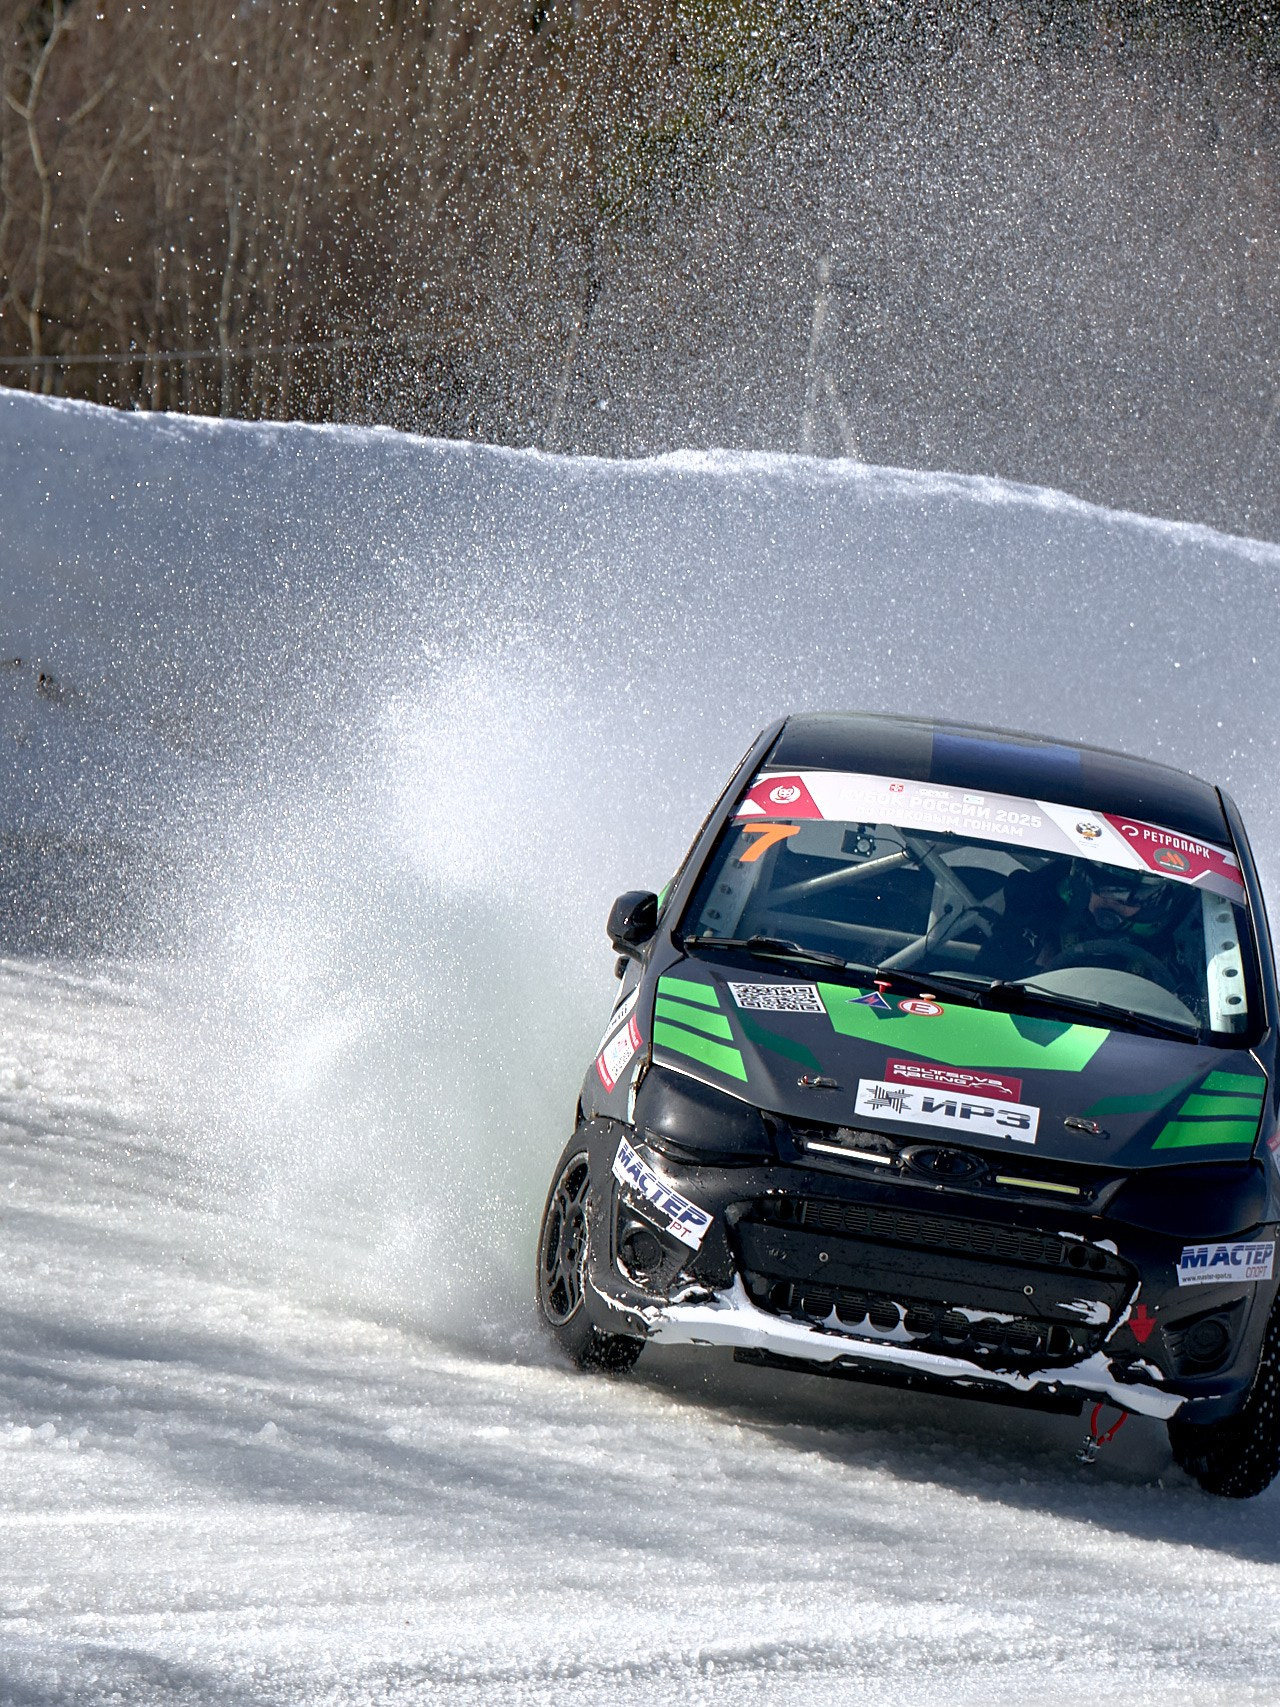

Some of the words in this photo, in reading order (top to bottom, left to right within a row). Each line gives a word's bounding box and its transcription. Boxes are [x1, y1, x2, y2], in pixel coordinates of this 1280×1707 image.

[909, 795, 991, 820] РОССИИ
[996, 810, 1042, 828] 2025
[739, 823, 801, 863] 7
[963, 818, 1024, 837] ГОНКАМ
[1143, 829, 1210, 859] РЕТРОПАРК
[921, 1096, 1031, 1130] ИРЗ
[617, 1143, 708, 1226] МАСТЕР
[1181, 1244, 1274, 1269] МАСТЕР
[1245, 1265, 1267, 1278] СПОРТ
